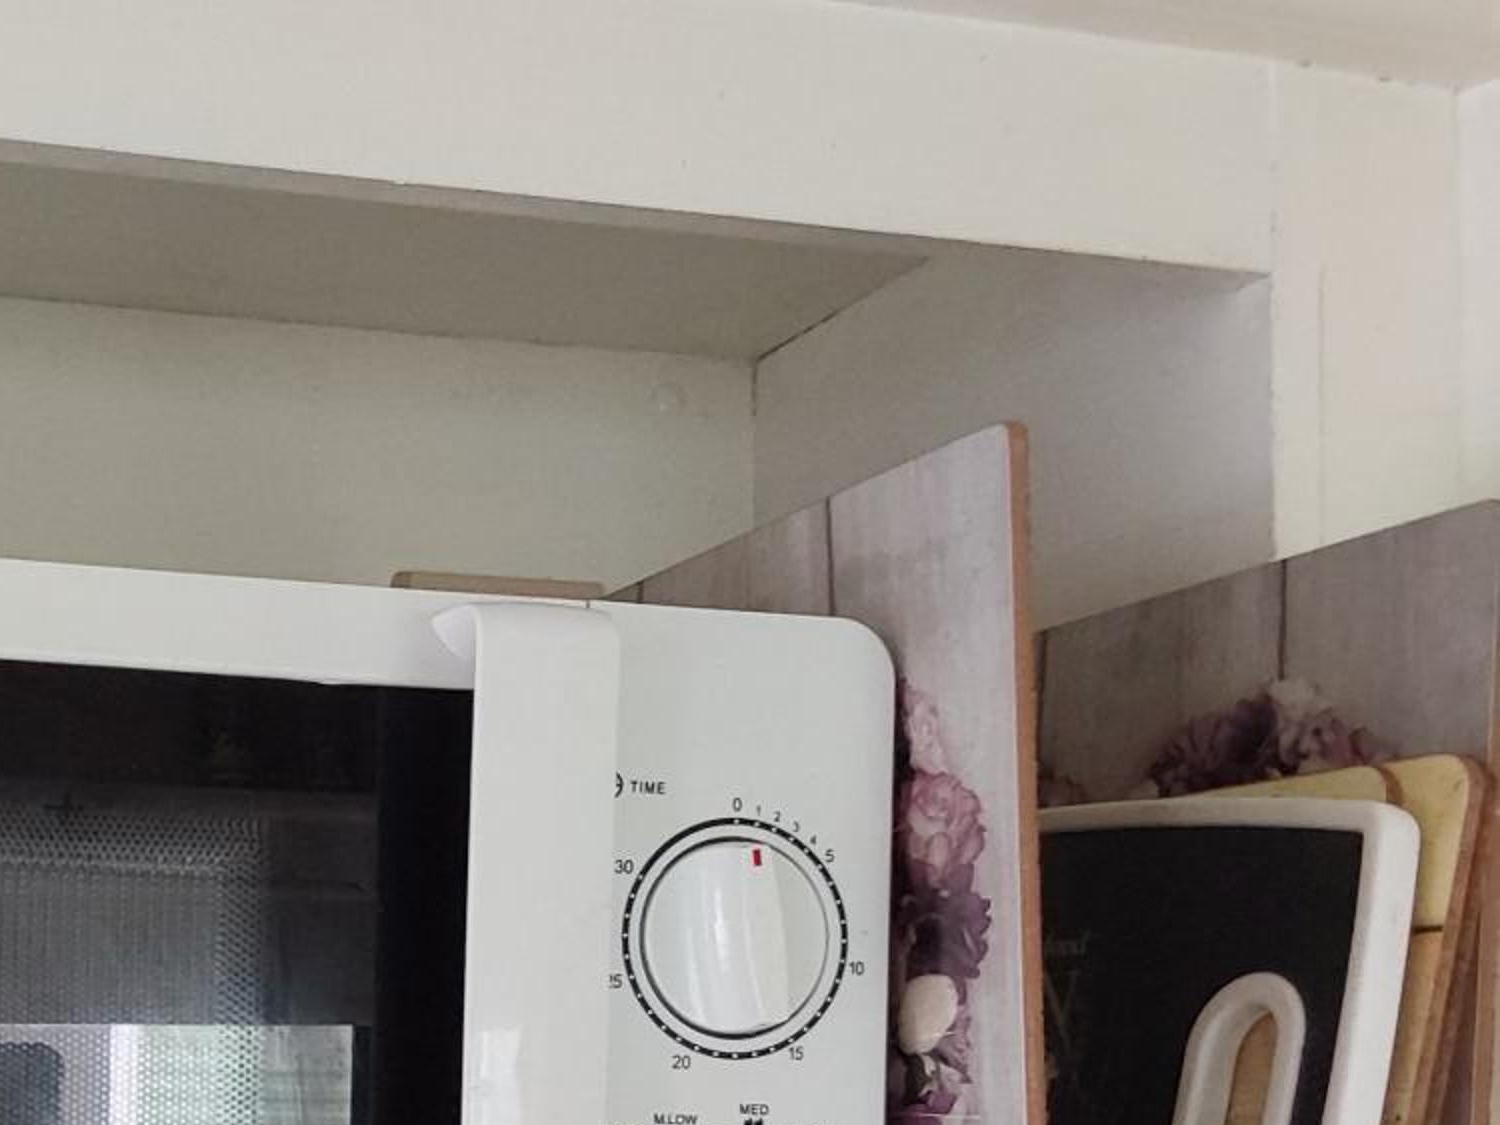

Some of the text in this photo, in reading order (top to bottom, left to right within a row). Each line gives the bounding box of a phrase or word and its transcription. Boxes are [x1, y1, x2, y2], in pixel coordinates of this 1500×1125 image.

[630, 781, 666, 795] TIME
[732, 797, 743, 812] 0
[773, 811, 781, 822] 2
[810, 835, 818, 845] 4
[825, 849, 836, 863] 5
[614, 859, 634, 874] 30
[849, 962, 865, 976] 10
[789, 1048, 804, 1061] 15
[672, 1056, 691, 1070] 20
[739, 1104, 769, 1116] MED
[653, 1113, 698, 1125] M.LOW
